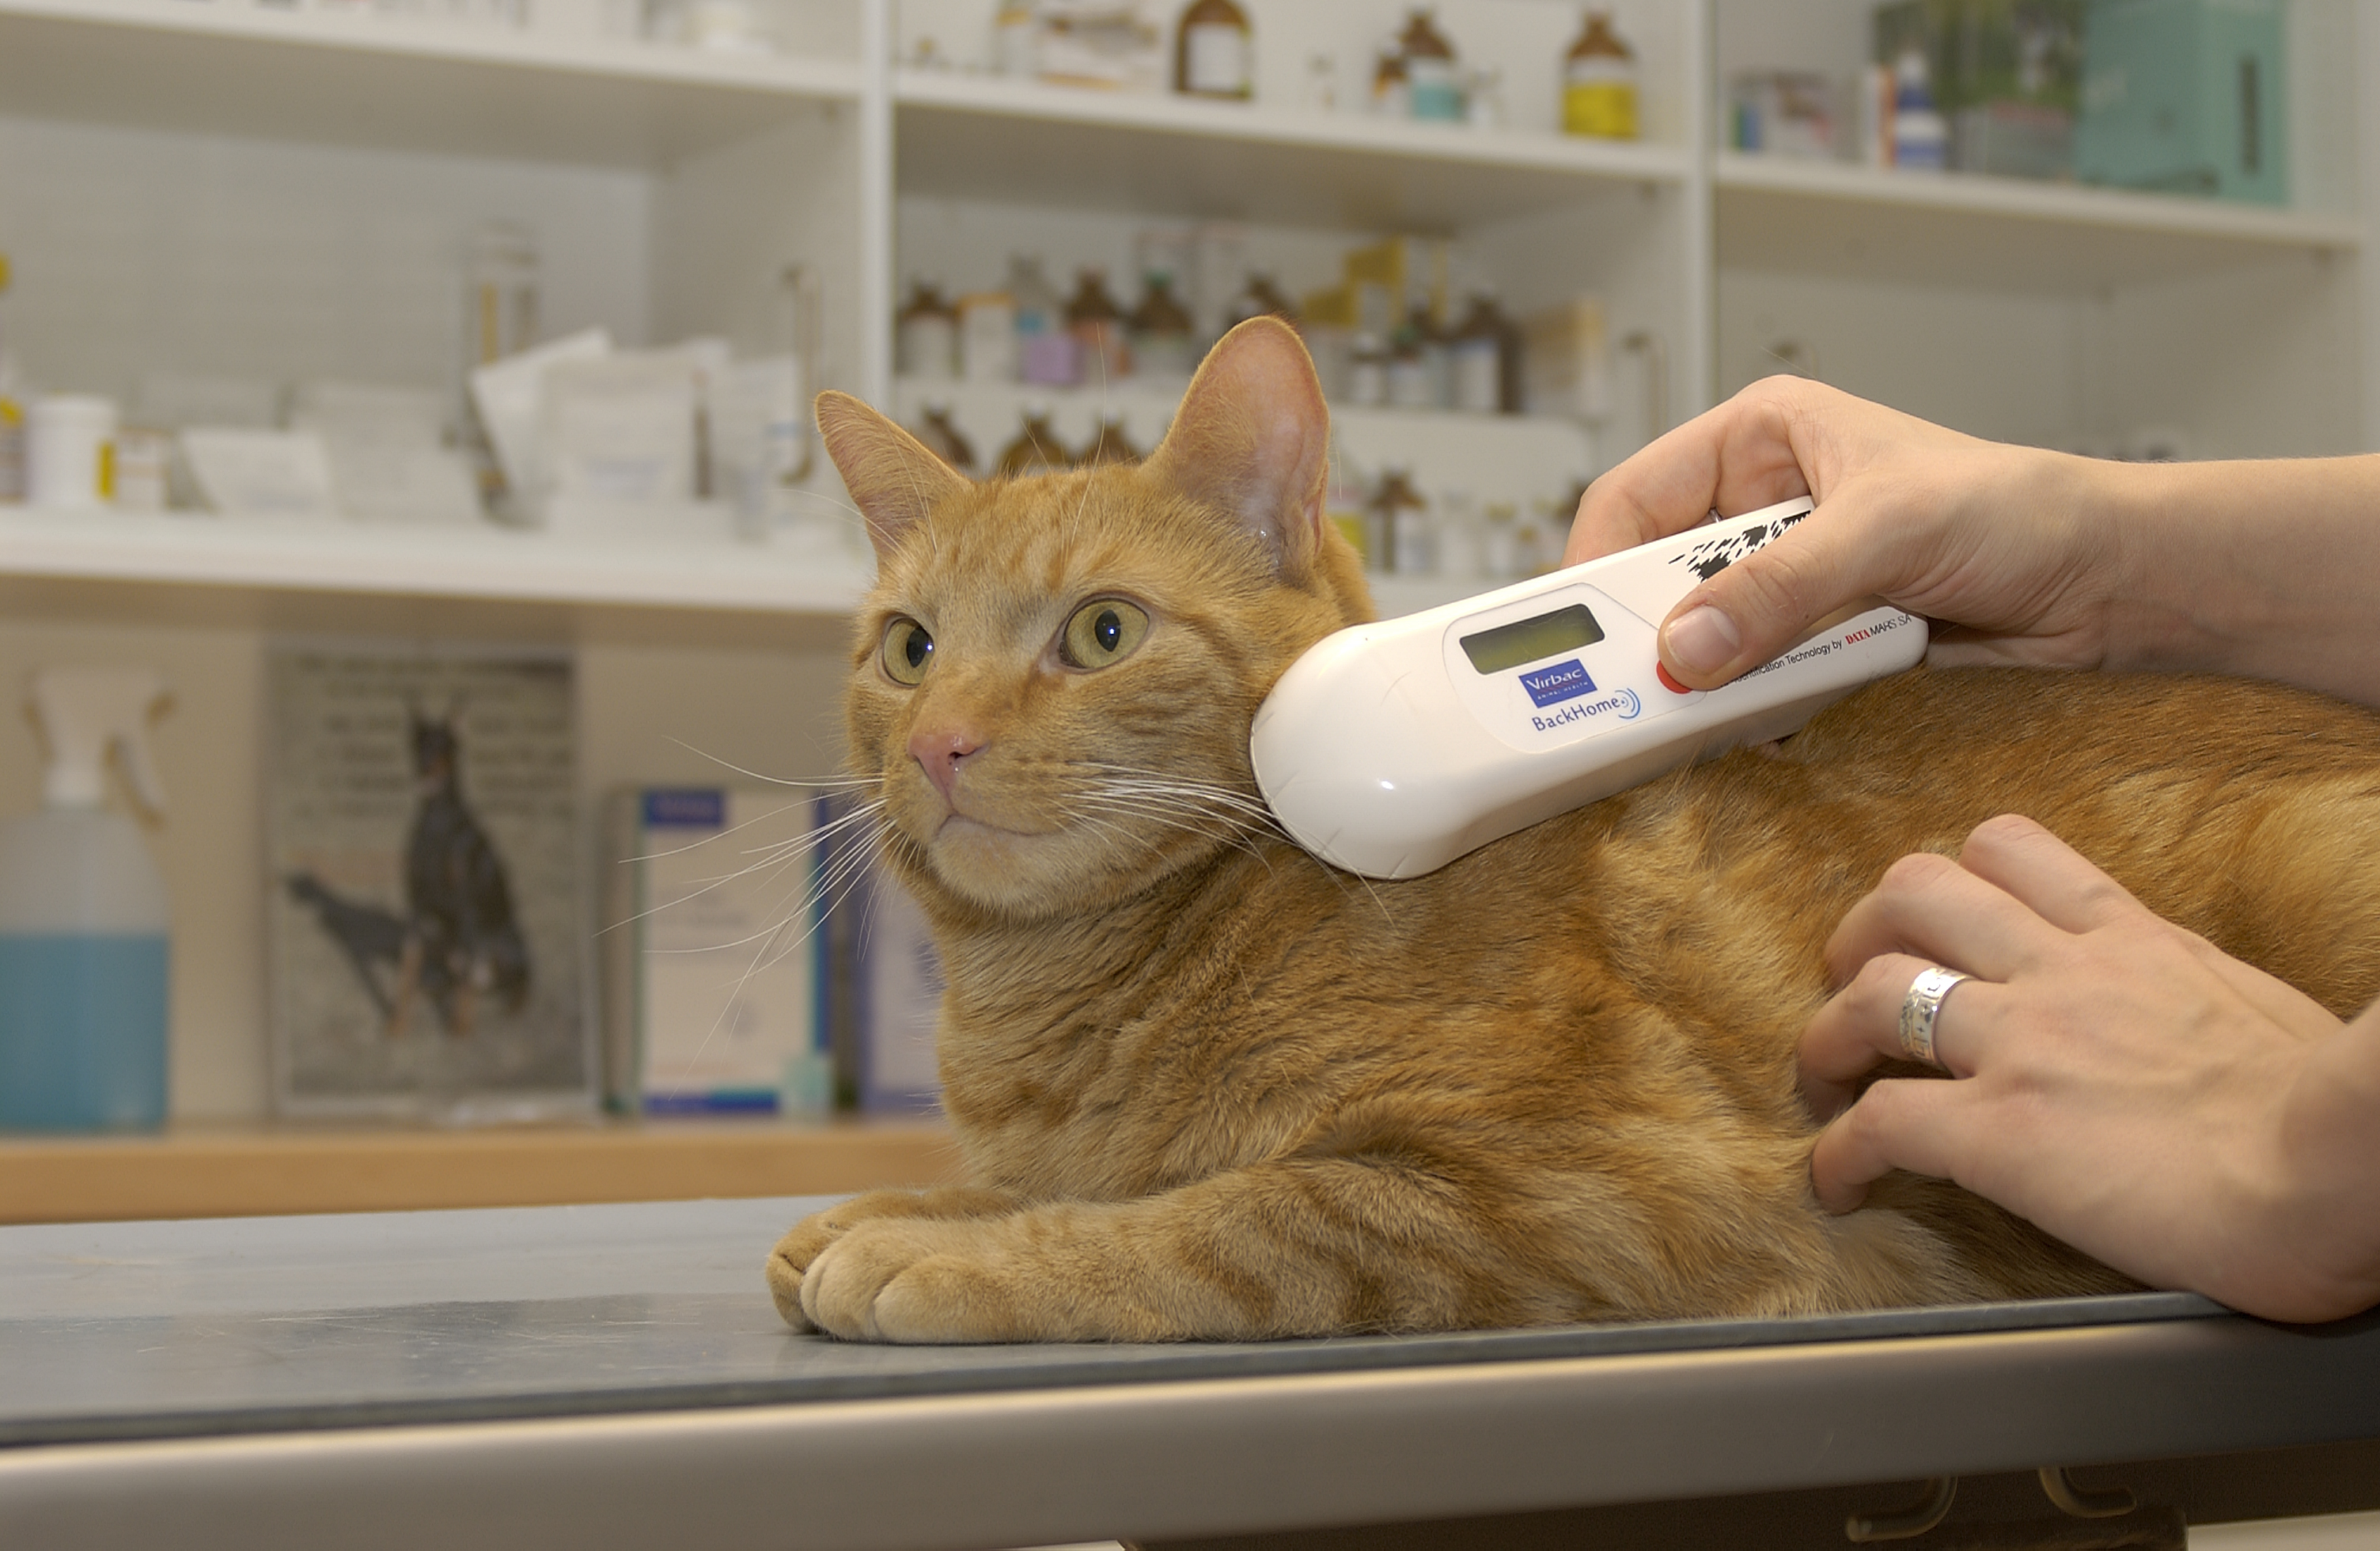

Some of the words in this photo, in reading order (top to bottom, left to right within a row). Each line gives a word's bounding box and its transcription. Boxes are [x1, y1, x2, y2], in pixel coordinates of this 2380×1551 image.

[1734, 660, 1785, 684] entification
[1785, 644, 1831, 665] Technology
[1832, 639, 1842, 650] by
[1897, 613, 1912, 626] SA
[1526, 669, 1582, 690] Virbac
[1532, 697, 1620, 731] BackHome
